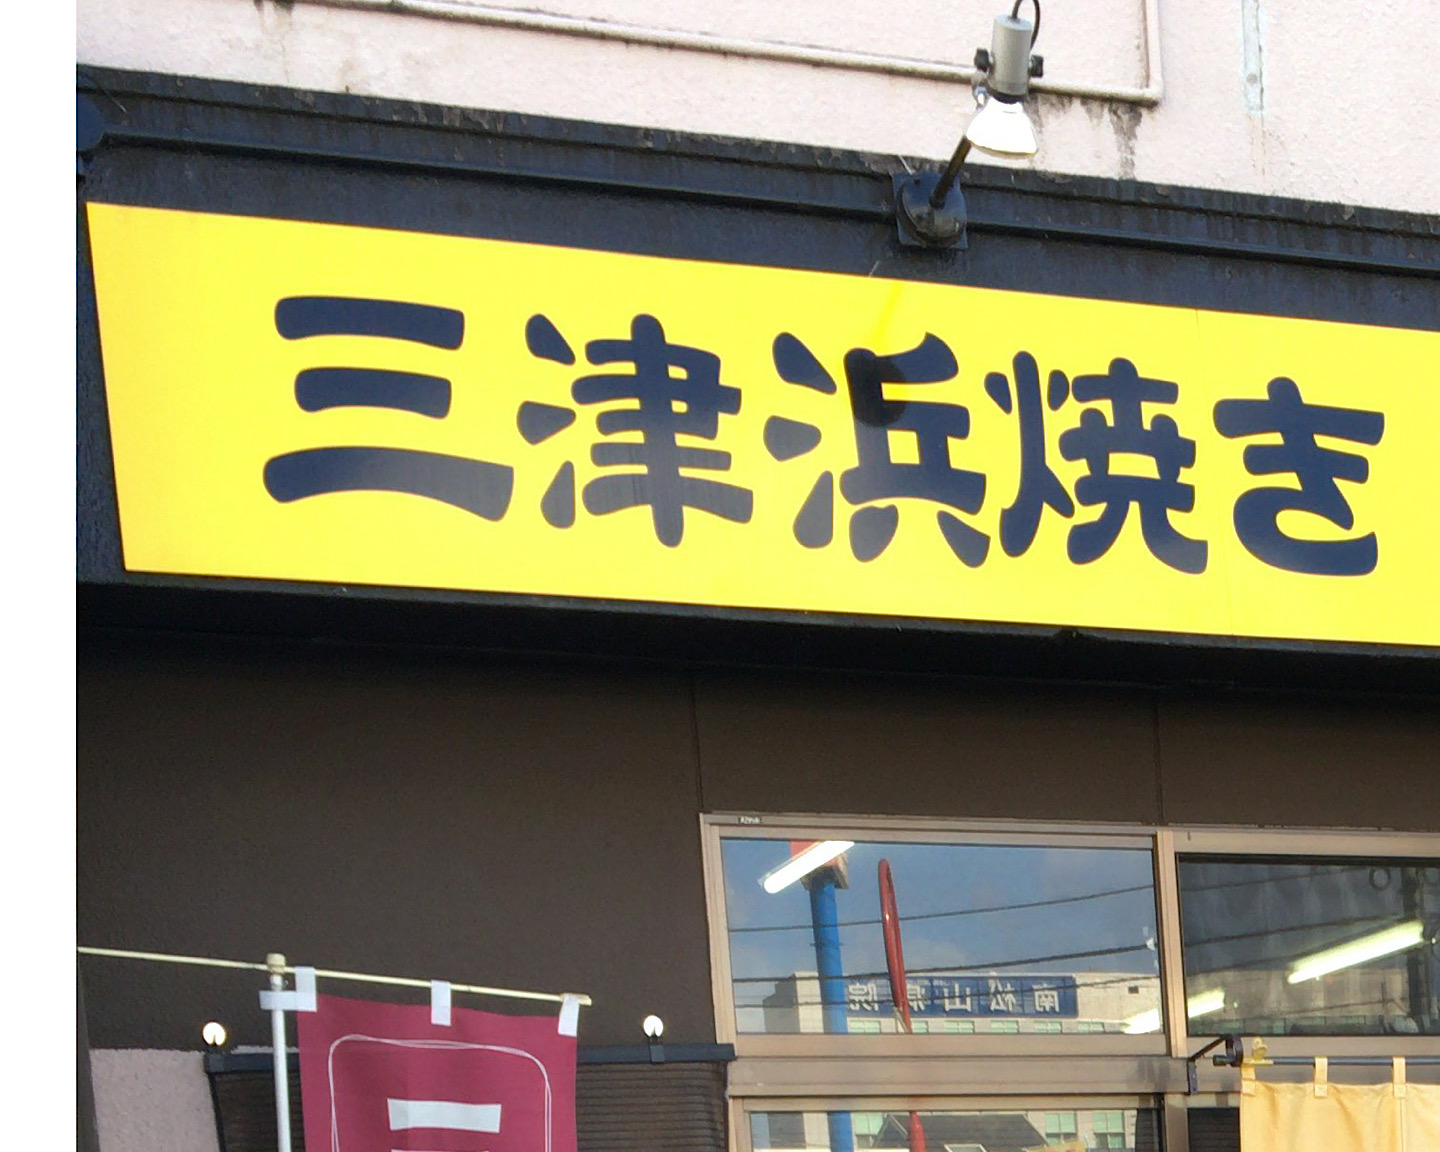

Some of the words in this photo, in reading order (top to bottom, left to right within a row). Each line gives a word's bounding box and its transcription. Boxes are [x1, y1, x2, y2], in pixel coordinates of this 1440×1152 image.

[263, 294, 1385, 577] 三津浜焼き
